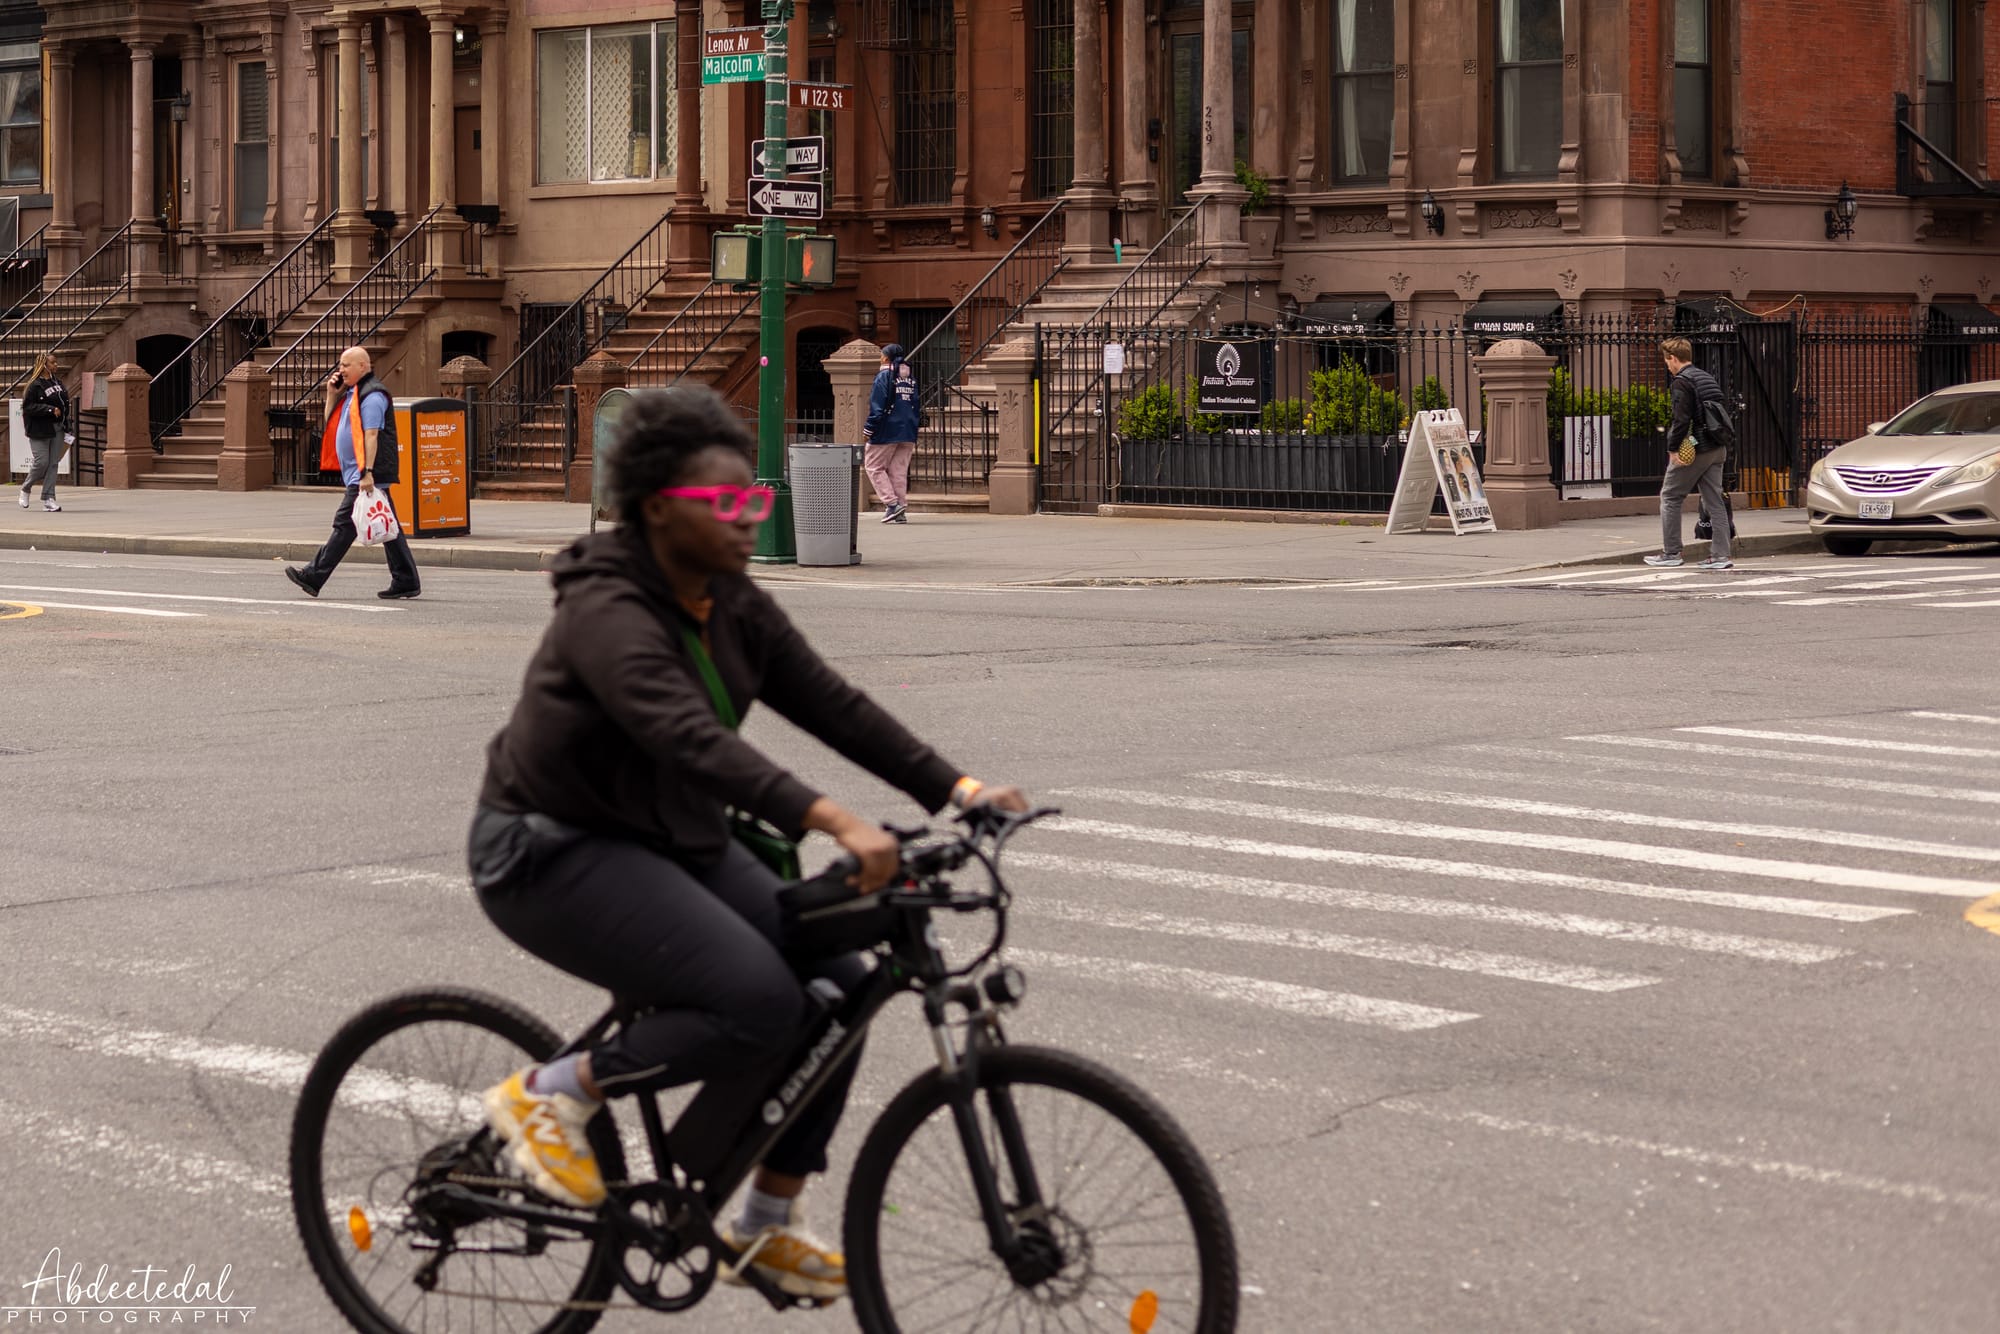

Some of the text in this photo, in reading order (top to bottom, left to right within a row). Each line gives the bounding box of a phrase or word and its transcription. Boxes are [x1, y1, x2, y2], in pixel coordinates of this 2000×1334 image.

[708, 34, 749, 53] Lenox Av
[705, 55, 764, 75] Malcolm X
[800, 89, 843, 108] W 122 St
[795, 148, 815, 162] WAY
[761, 191, 814, 207] ONE WAY
[1201, 374, 1255, 387] Indian Summer
